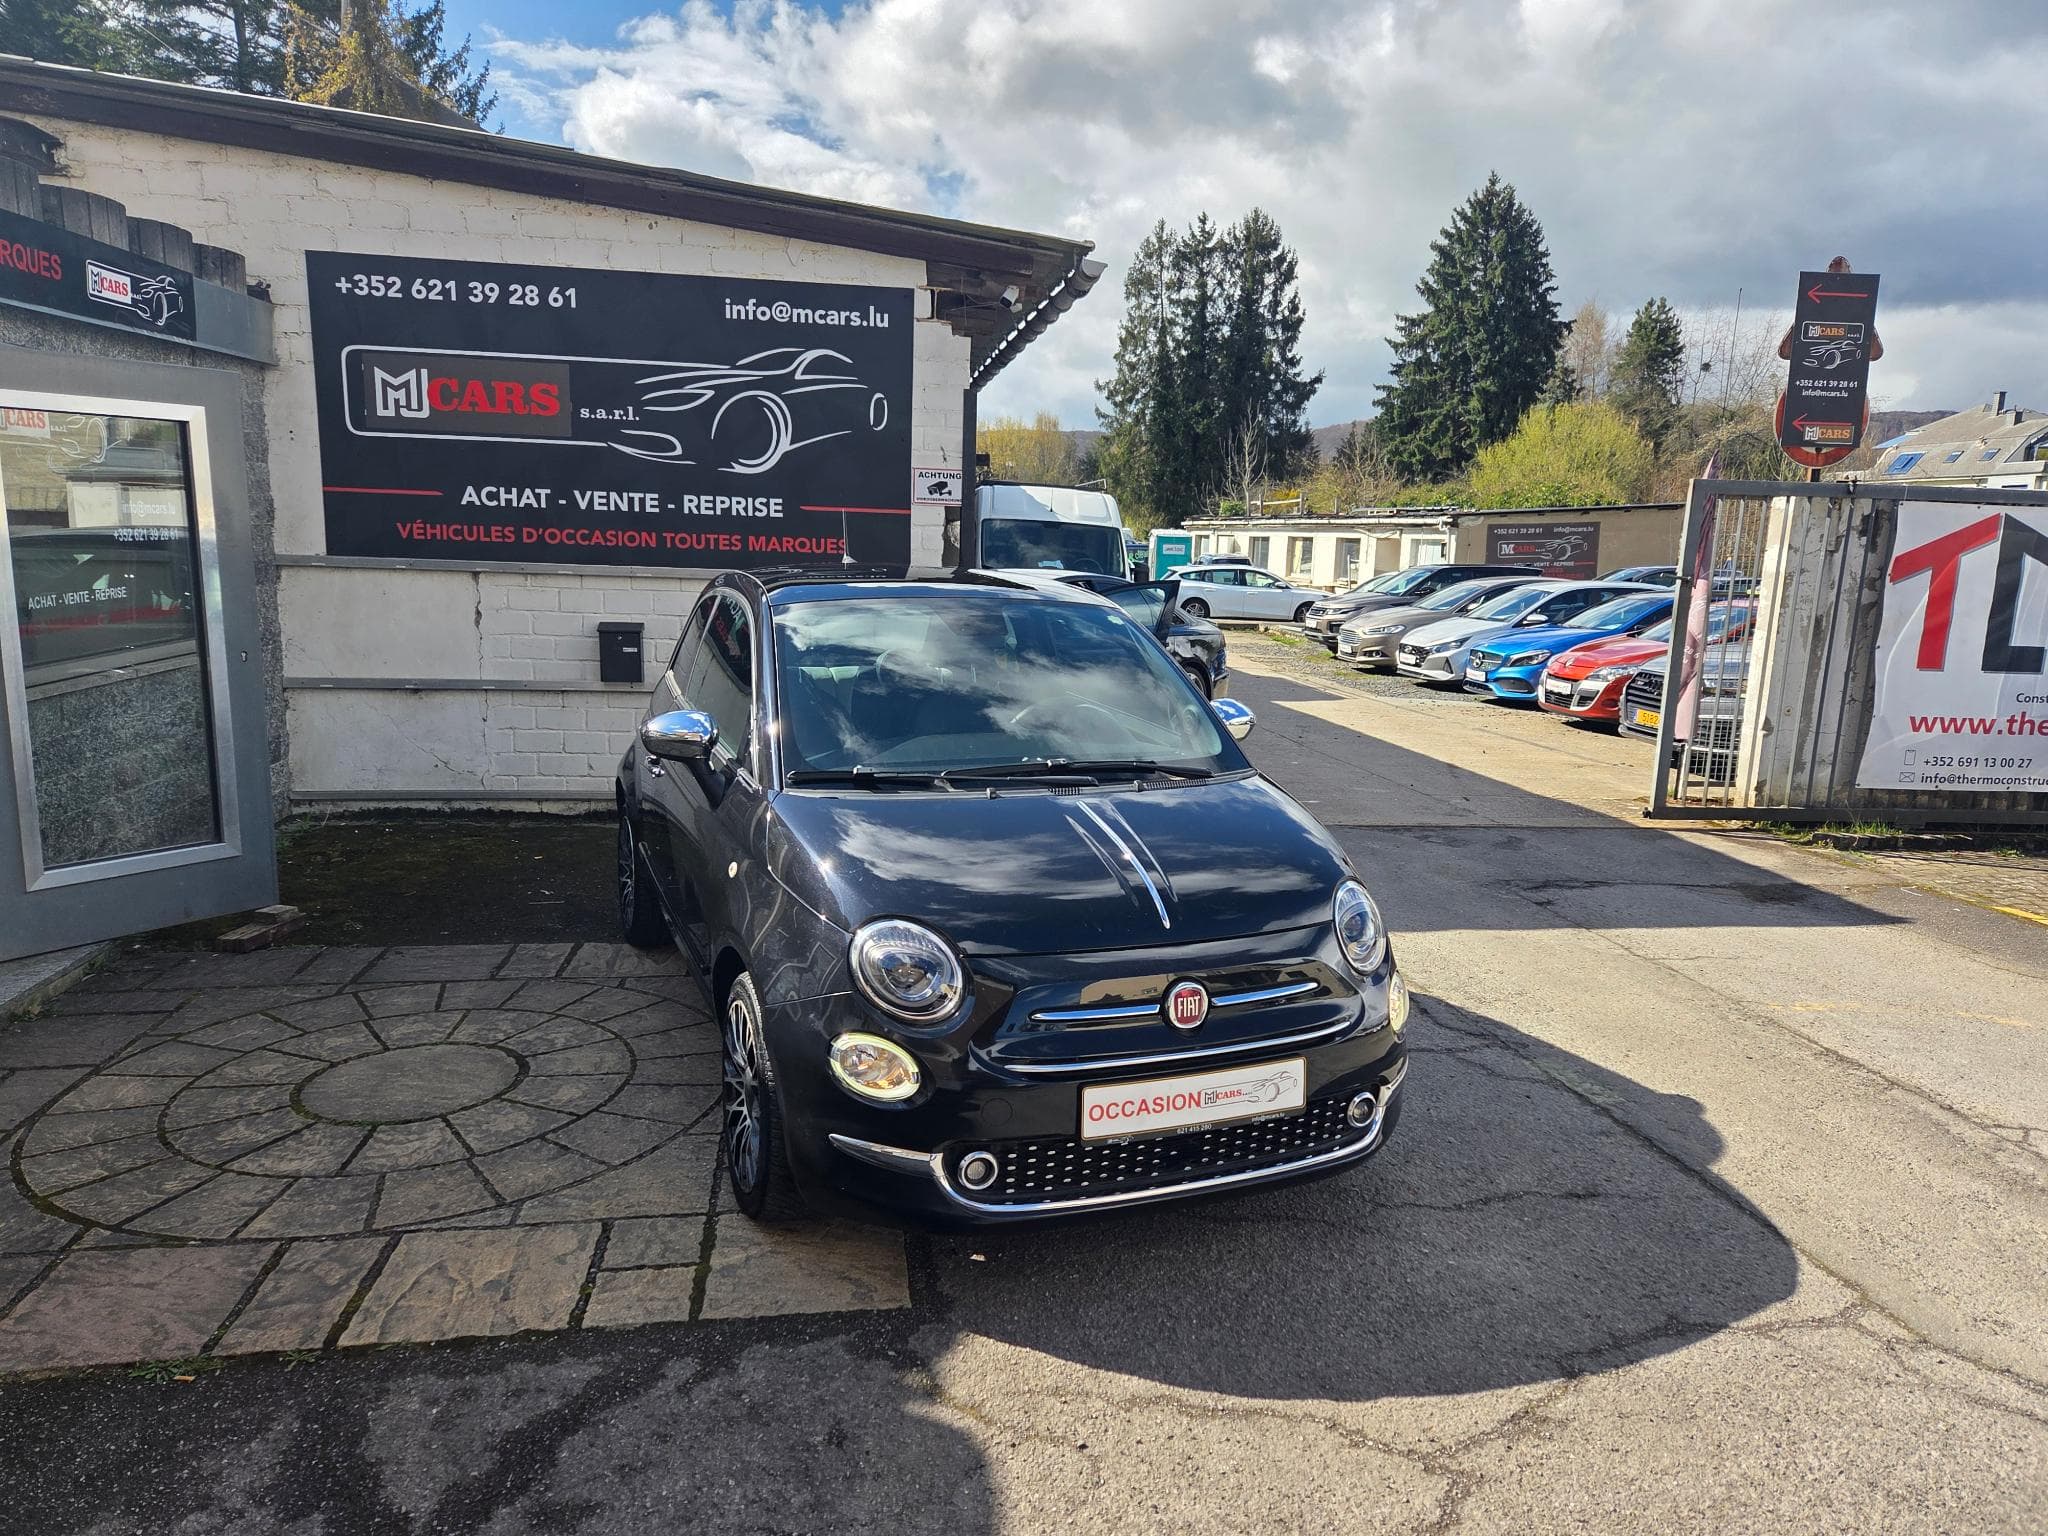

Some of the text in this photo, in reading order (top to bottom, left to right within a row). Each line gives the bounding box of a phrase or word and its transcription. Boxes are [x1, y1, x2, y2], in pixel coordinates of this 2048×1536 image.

[335, 273, 577, 308] +352 621 39 28 61
[725, 298, 889, 328] info@mcars.lu
[1802, 389, 1849, 397] info@mcars.lu
[580, 405, 641, 422] s.a.r.l.
[918, 471, 962, 480] ACHTUNG
[461, 485, 551, 509] ACHAT
[573, 490, 660, 513] VENTE
[683, 494, 784, 518] REPRISE
[113, 529, 133, 542] +352
[134, 529, 148, 541] 621
[150, 528, 160, 541] 39
[160, 528, 170, 541] 28
[396, 520, 516, 543] VÉHICULES
[522, 527, 657, 549] D'OCCASION
[663, 532, 742, 551] TOUTES
[28, 594, 57, 611] ACHAT
[62, 591, 90, 605] VENTE
[95, 586, 127, 601] REPRISE
[1909, 711, 2048, 736] www.the
[1923, 756, 2033, 769] +352 691 13 00 27
[1177, 995, 1201, 1018] FIAT
[1088, 1091, 1201, 1122] OCCASION
